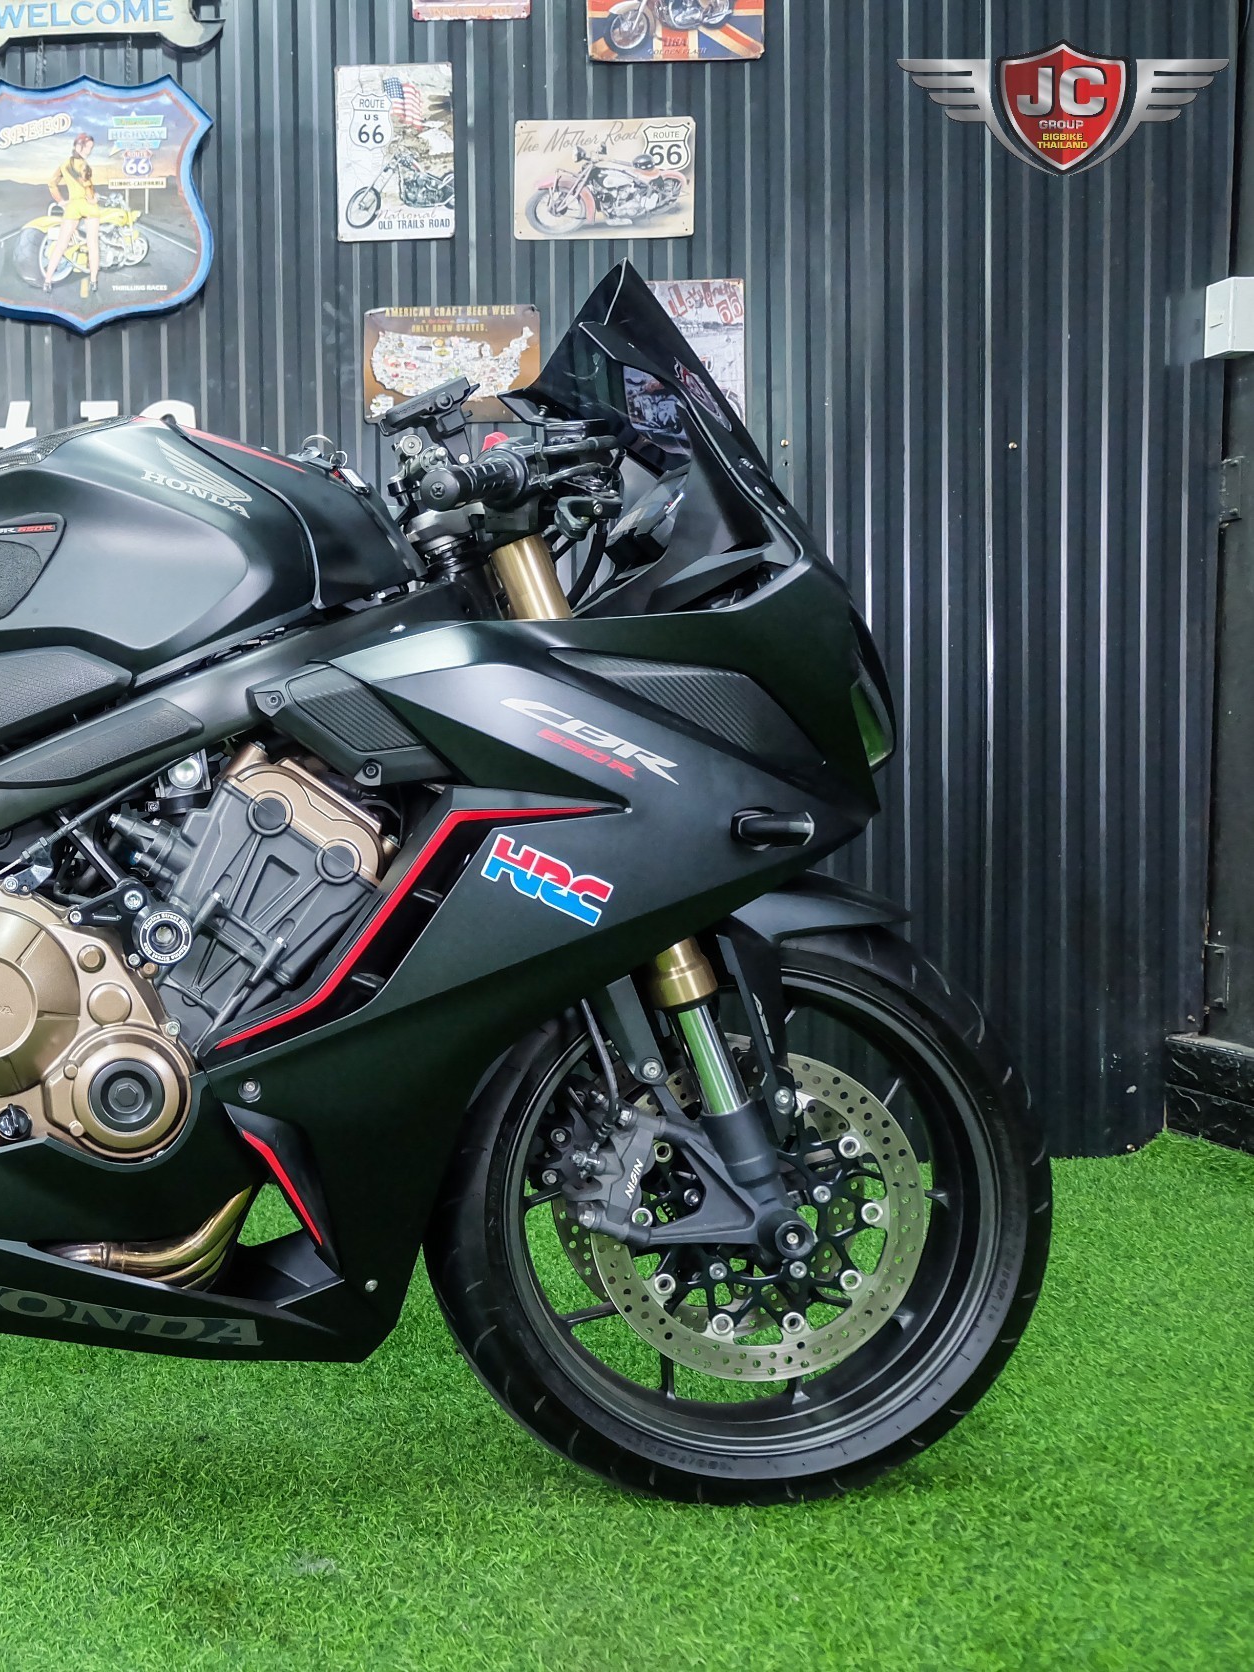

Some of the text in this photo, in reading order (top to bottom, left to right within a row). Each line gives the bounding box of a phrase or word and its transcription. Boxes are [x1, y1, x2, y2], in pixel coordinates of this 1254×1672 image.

[359, 98, 385, 108] ROUTE
[111, 130, 163, 139] HIGHWAY
[358, 123, 384, 144] 66
[517, 121, 644, 156] The Mother Road
[653, 130, 680, 139] ROUTE
[649, 143, 683, 166] 66
[125, 158, 150, 175] 66
[378, 218, 451, 230] OLD TRAILS ROAD
[384, 305, 516, 318] AMERICAN CRAFT BEER WEEK
[140, 469, 251, 519] HONDA
[500, 697, 680, 786] CBR
[537, 727, 637, 780] 650R
[482, 834, 615, 927] HRC
[625, 1157, 644, 1200] NISSIN
